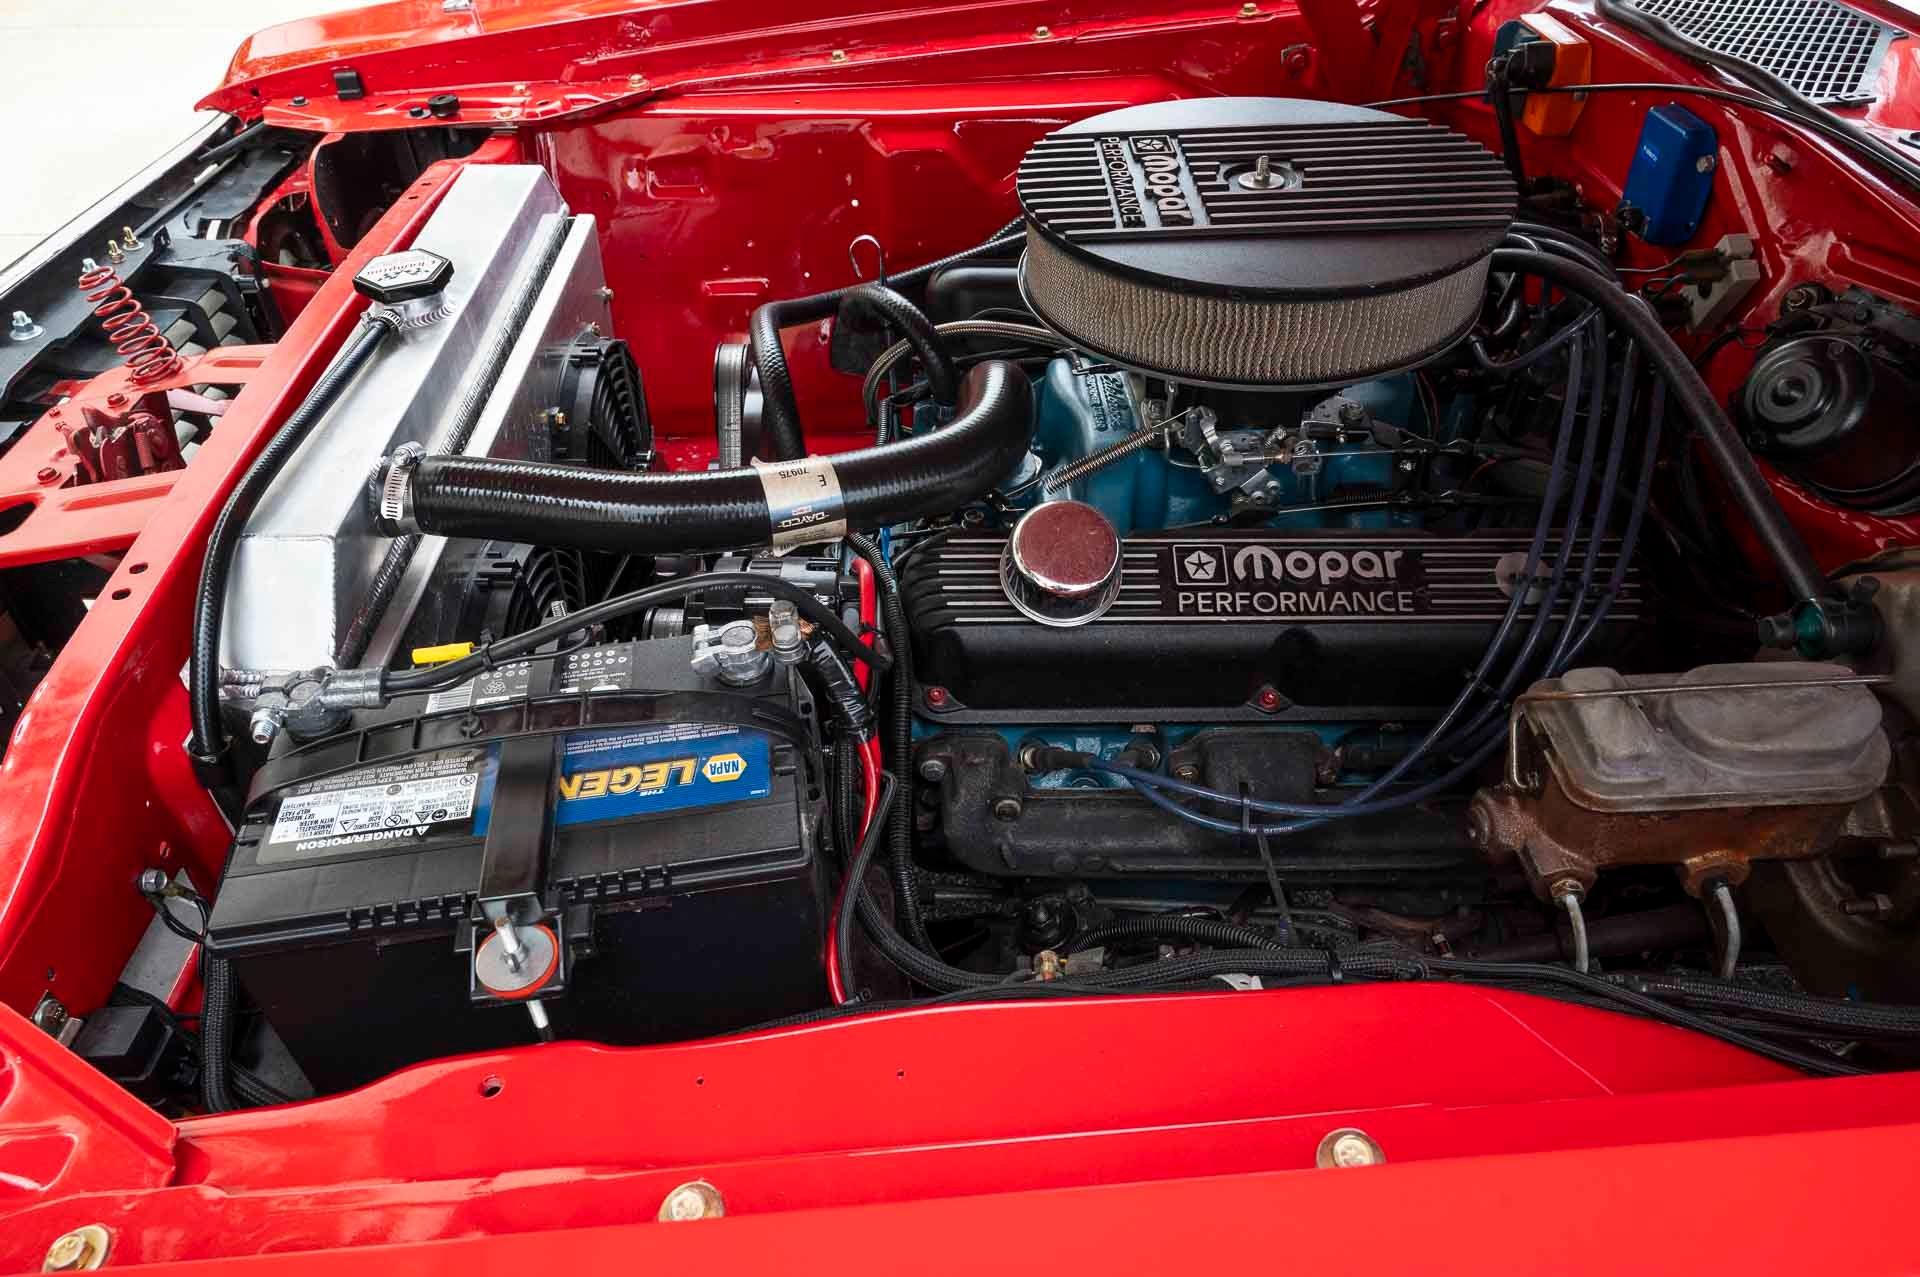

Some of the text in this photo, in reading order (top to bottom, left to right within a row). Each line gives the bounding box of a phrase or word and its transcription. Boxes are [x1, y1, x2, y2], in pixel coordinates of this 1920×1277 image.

[1101, 137, 1143, 222] PERFORMANCE
[779, 467, 809, 479] 70975
[818, 474, 827, 487] E
[777, 512, 829, 528] DAYCO
[1178, 591, 1414, 613] PERFORMANCE
[709, 759, 740, 776] NAPA
[561, 757, 698, 800] LEGEN
[639, 788, 665, 797] THE
[296, 828, 414, 851] DANGER/POISON
